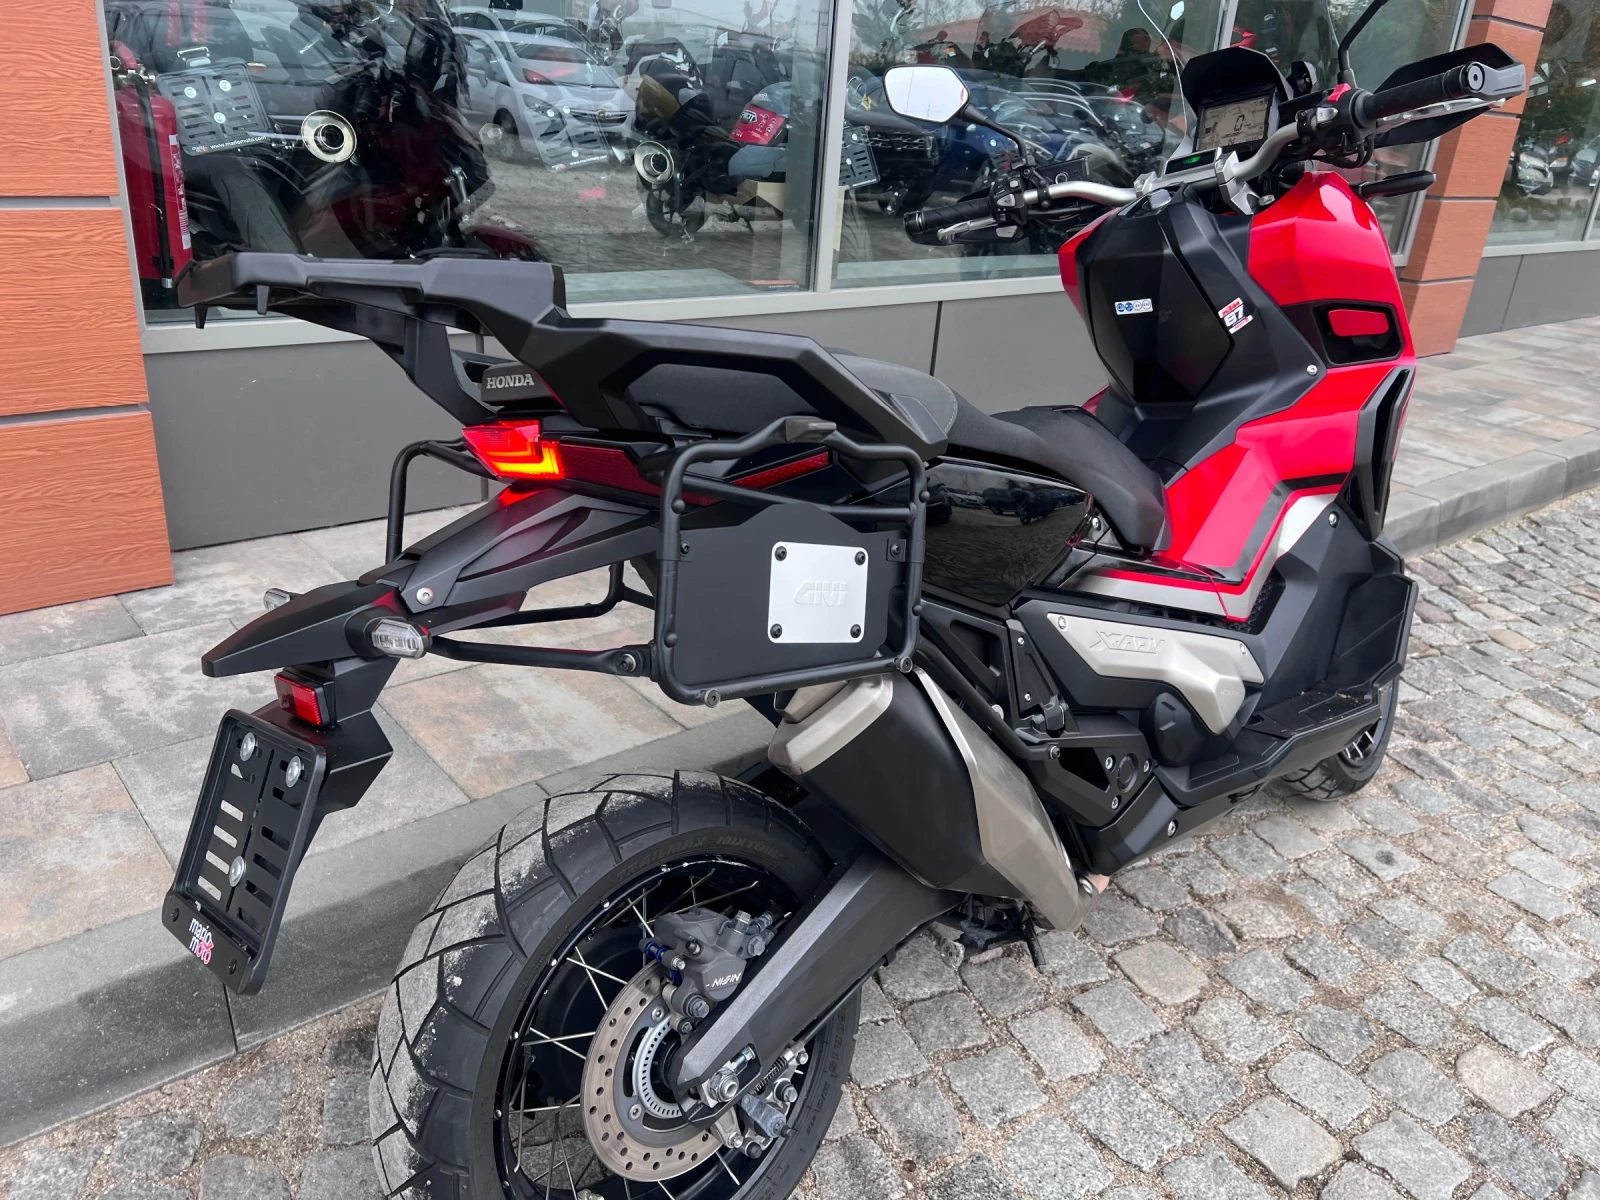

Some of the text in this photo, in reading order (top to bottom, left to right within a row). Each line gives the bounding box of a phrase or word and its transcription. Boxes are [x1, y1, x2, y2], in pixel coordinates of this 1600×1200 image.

[486, 373, 535, 389] HONDA
[793, 580, 848, 607] GIVI
[188, 917, 213, 946] mario
[188, 935, 213, 965] moto
[711, 972, 742, 989] NISSIN
